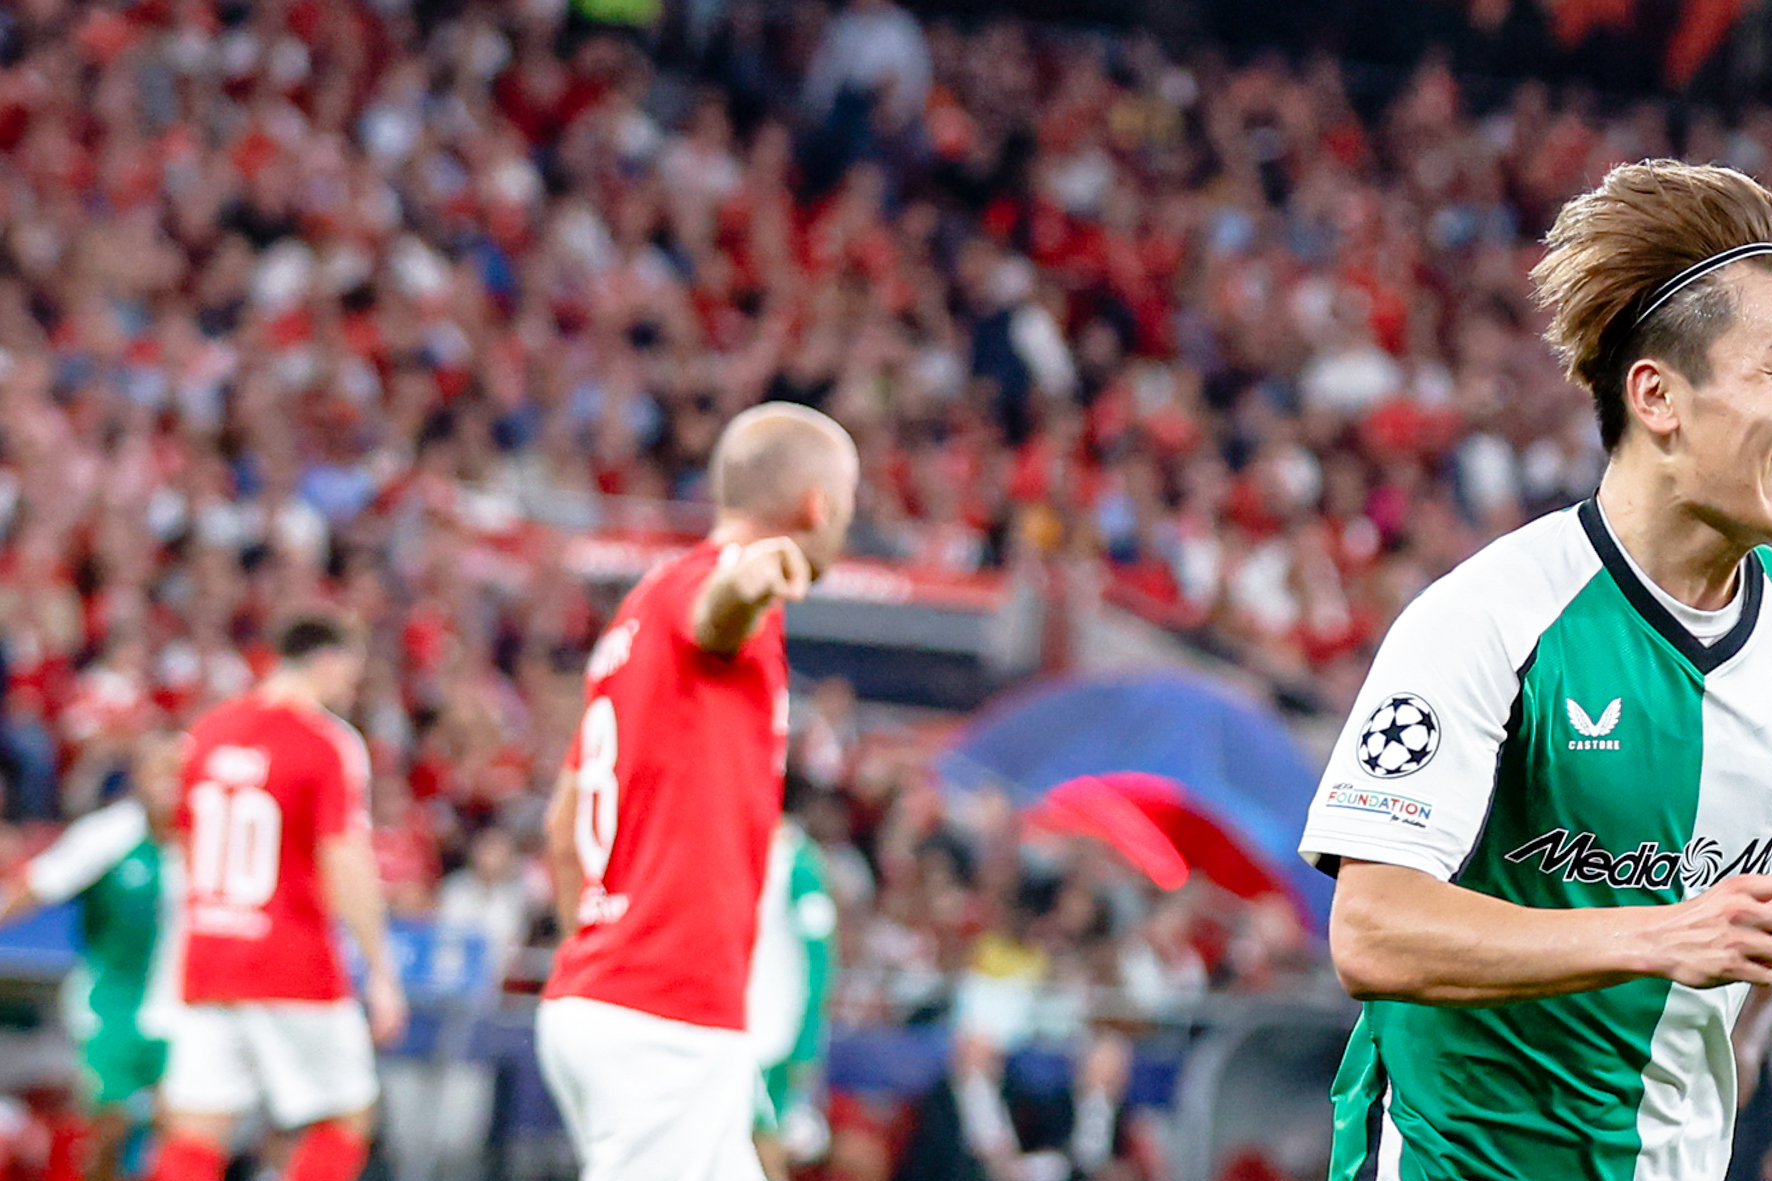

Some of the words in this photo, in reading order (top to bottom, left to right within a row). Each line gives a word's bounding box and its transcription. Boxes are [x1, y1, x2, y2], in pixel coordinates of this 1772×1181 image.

[1568, 740, 1620, 750] CASTORE
[1332, 782, 1353, 790] UEFA
[1327, 791, 1432, 820] FOUNDATION
[188, 780, 282, 908] 10
[1504, 828, 1682, 889] Media
